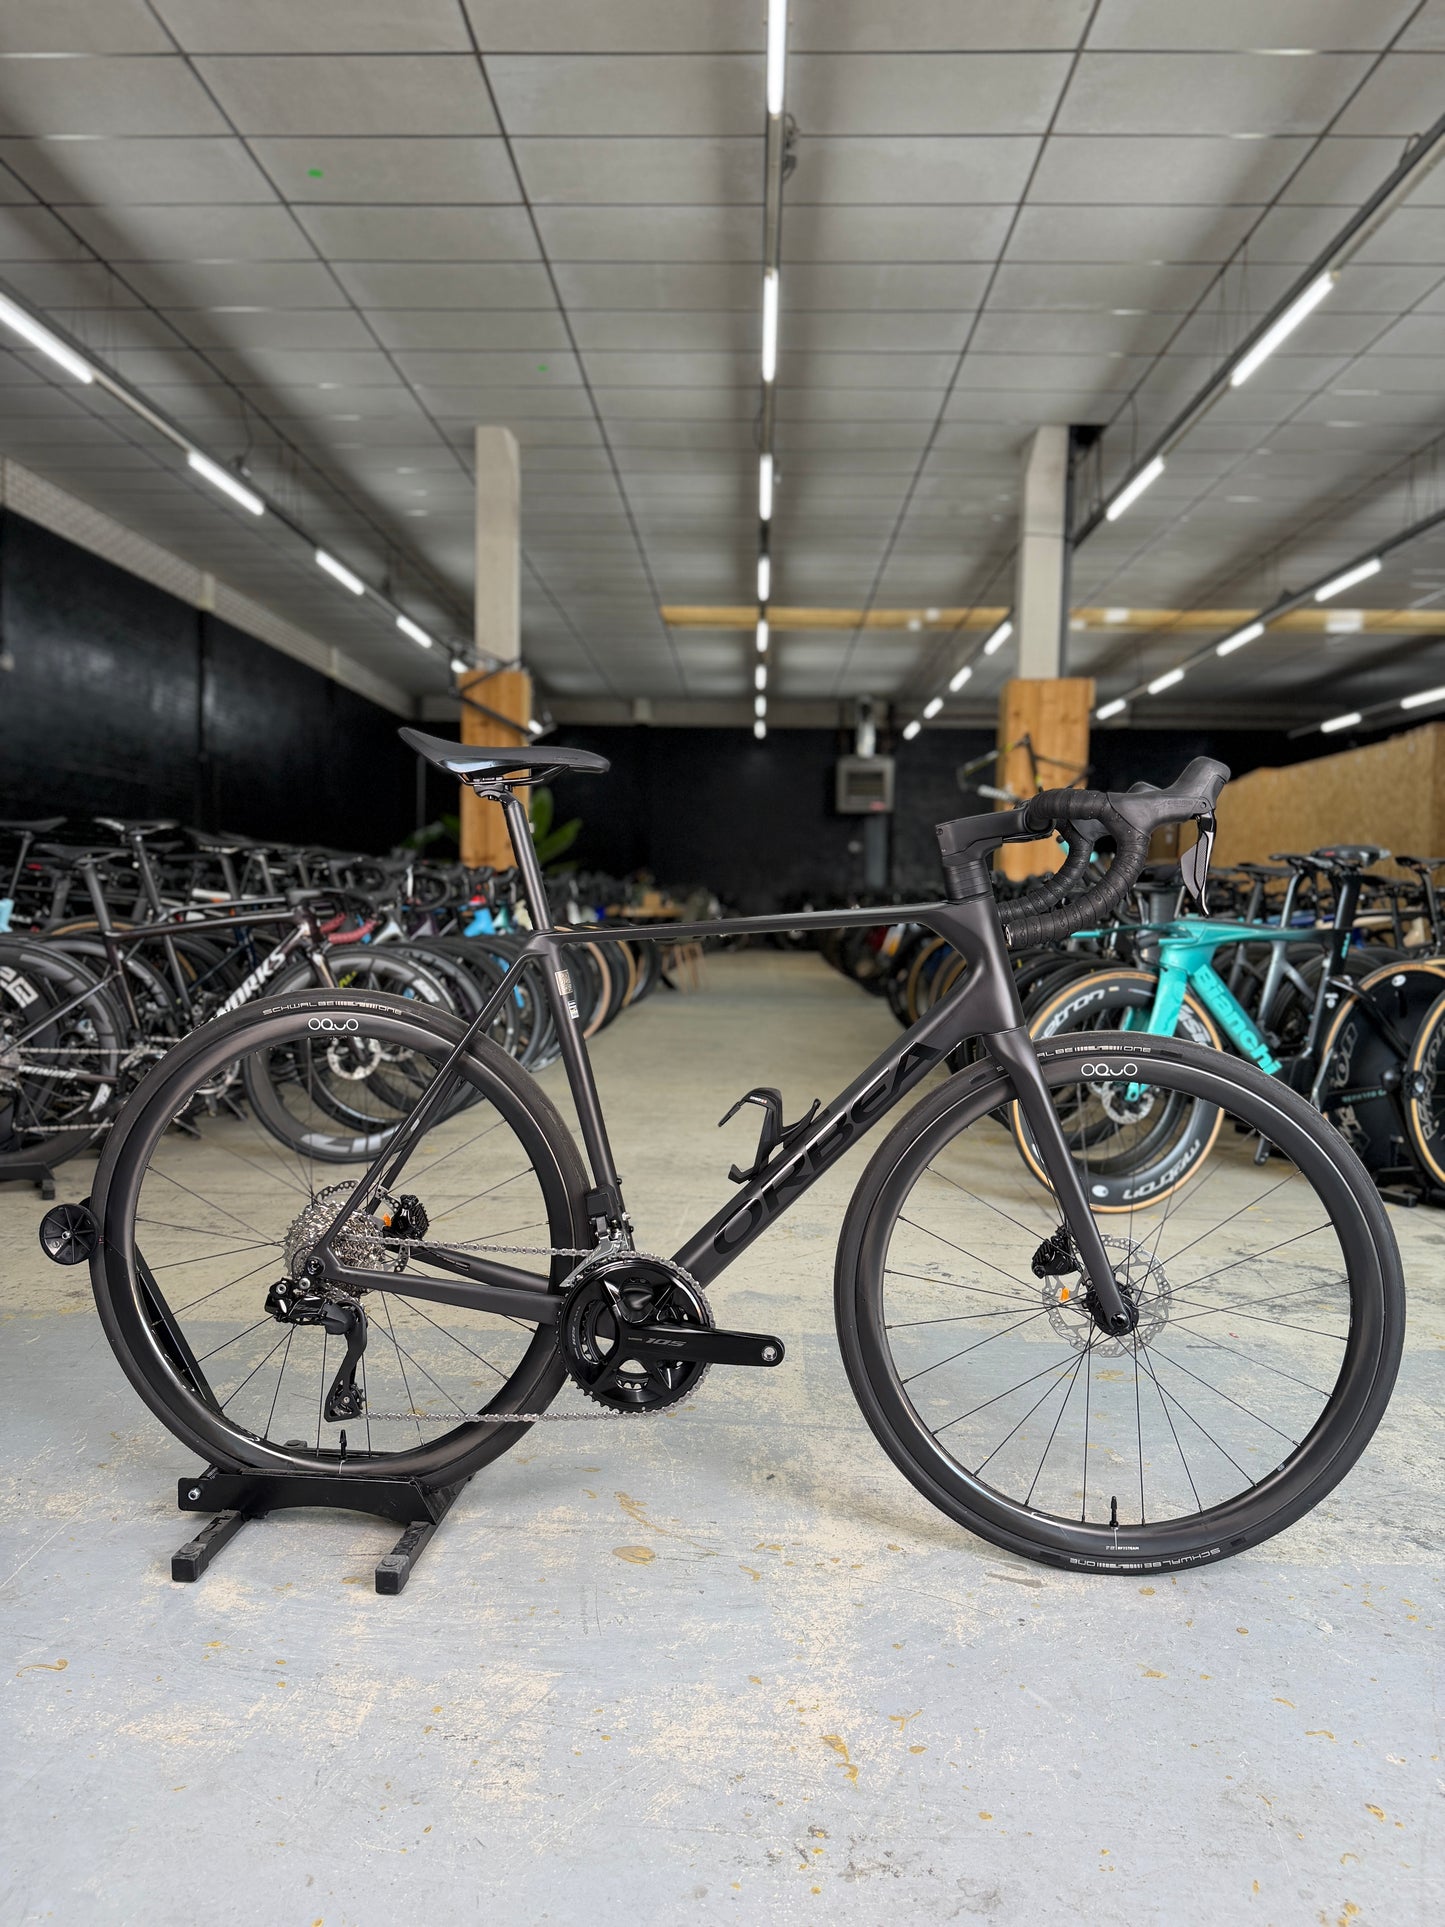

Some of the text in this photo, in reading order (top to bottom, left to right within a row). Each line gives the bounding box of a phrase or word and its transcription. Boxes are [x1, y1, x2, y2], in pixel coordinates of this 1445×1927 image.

[262, 1000, 335, 1016] SCHWALBE
[1042, 989, 1105, 1038] etron
[1194, 963, 1283, 1075] Bianchi
[713, 1041, 943, 1255] ORBEA
[1122, 1139, 1201, 1200] metron
[646, 1337, 688, 1347] 105
[1144, 1547, 1221, 1569] SCHWALBE
